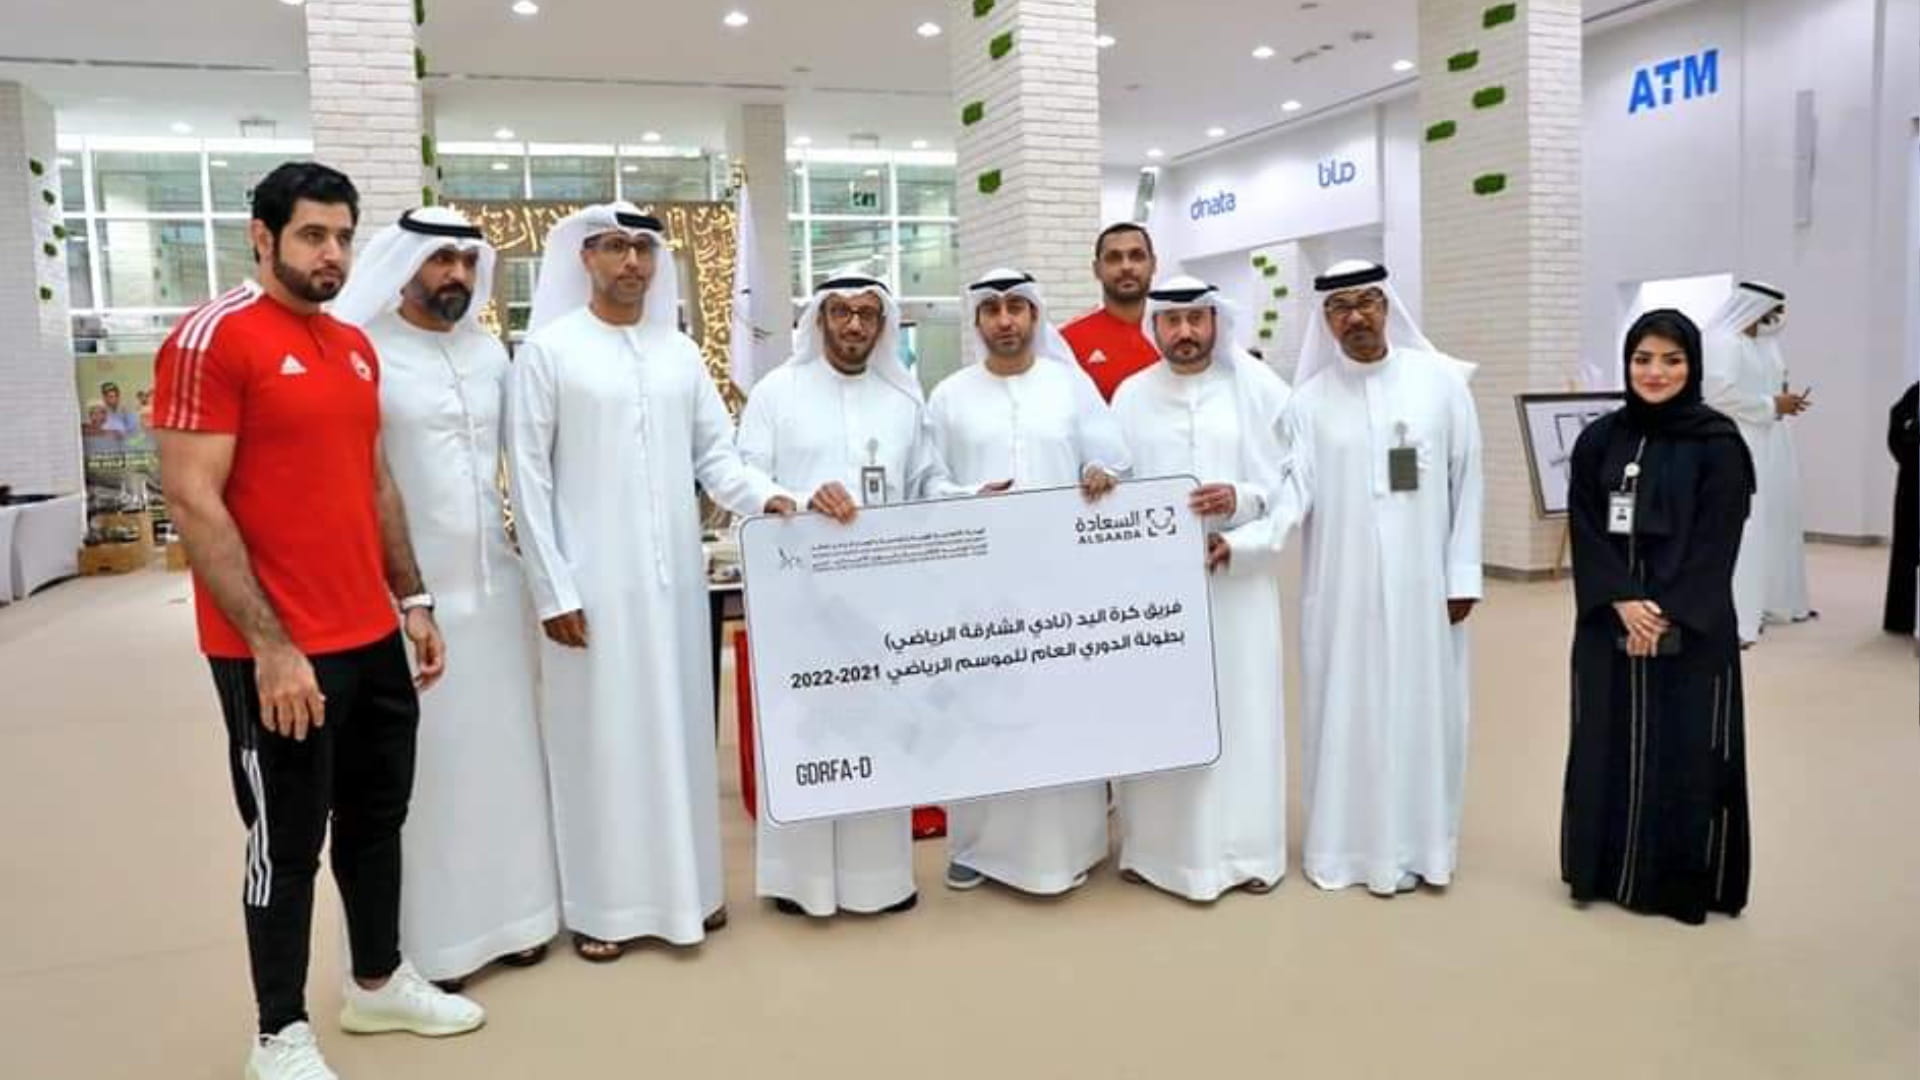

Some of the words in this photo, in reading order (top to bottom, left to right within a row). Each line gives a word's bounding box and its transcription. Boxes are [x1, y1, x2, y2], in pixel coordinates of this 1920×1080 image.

[1628, 48, 1718, 114] ATM
[1190, 191, 1236, 220] dnata
[1075, 510, 1140, 533] السعادة
[1077, 529, 1142, 545] ALSAADA
[1076, 608, 1106, 629] اليد
[1108, 604, 1141, 624] كرة
[1143, 600, 1183, 621] فريق
[959, 615, 1026, 642] الشارقة
[1028, 611, 1073, 637] (نادي
[884, 625, 957, 653] الرياضي)
[1079, 634, 1131, 660] الدوري
[1133, 629, 1186, 649] بطولة
[954, 647, 1028, 673] للموسم
[1030, 641, 1076, 664] العام
[886, 656, 952, 684] الرياضي
[796, 756, 873, 787] GDRFA-D
